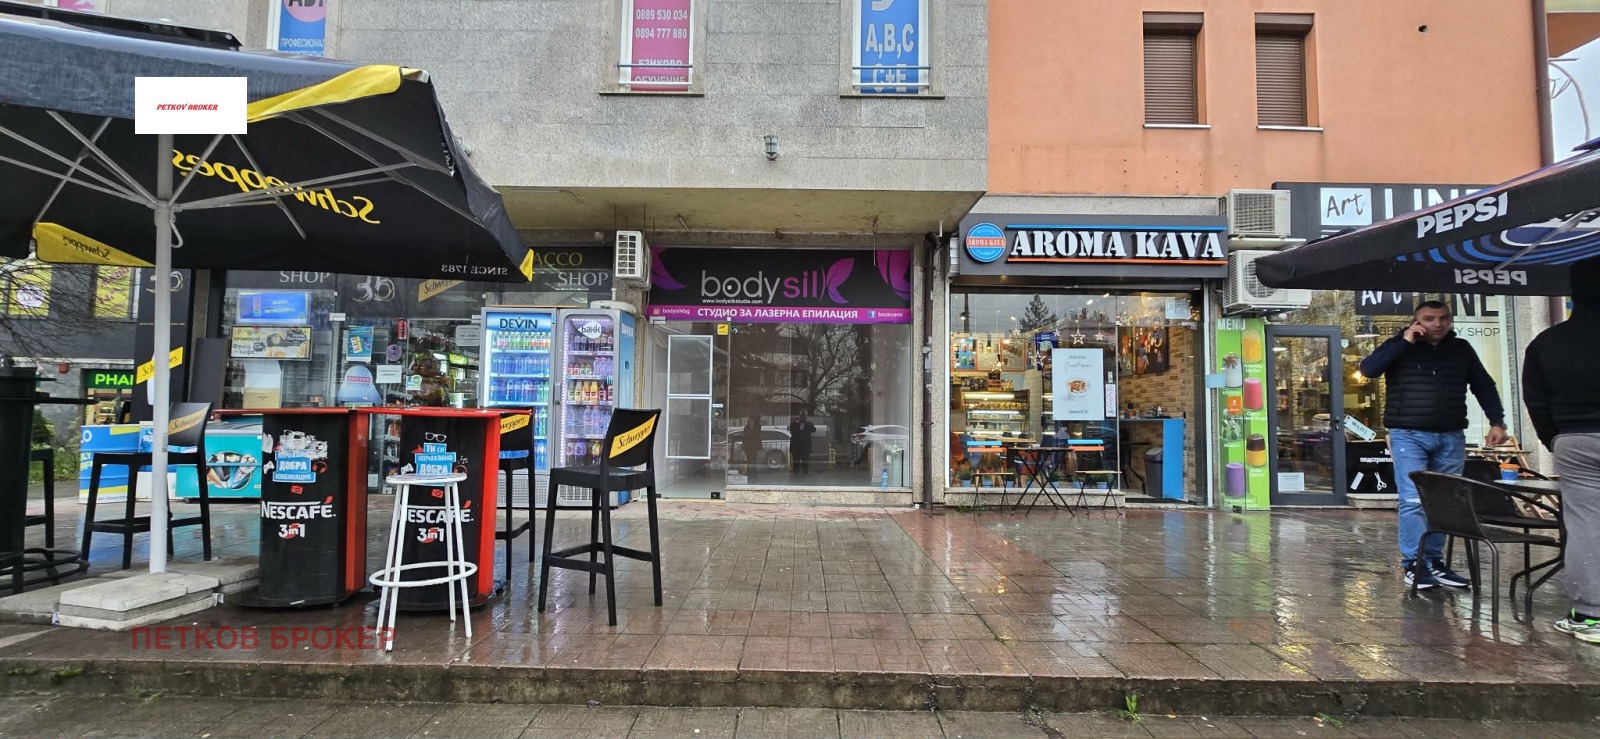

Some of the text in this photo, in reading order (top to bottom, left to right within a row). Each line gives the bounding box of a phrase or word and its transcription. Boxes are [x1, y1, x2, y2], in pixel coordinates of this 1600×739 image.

[636, 9, 688, 20] 0889 530 034
[635, 28, 687, 39] 0894 777 880
[865, 23, 914, 59] A,B,C
[1326, 193, 1364, 218] Art
[1416, 191, 1508, 239] PEPSI
[968, 238, 1005, 247] AROMA KAVA
[1010, 230, 1224, 258] AROMA KAVA
[558, 271, 609, 286] SHOP
[697, 308, 858, 320] СТУДИО ЗА ЛАЗЕРНА ЕПИЛАЦИЯ
[500, 316, 538, 330] DEVIN
[1217, 319, 1246, 331] MENU
[1467, 327, 1500, 337] SHOP
[1351, 420, 1368, 435] WAHL
[280, 461, 307, 471] ДОБРА
[420, 464, 448, 476] ДОБРА
[278, 523, 306, 538] 3in1
[417, 527, 445, 542] 3in1
